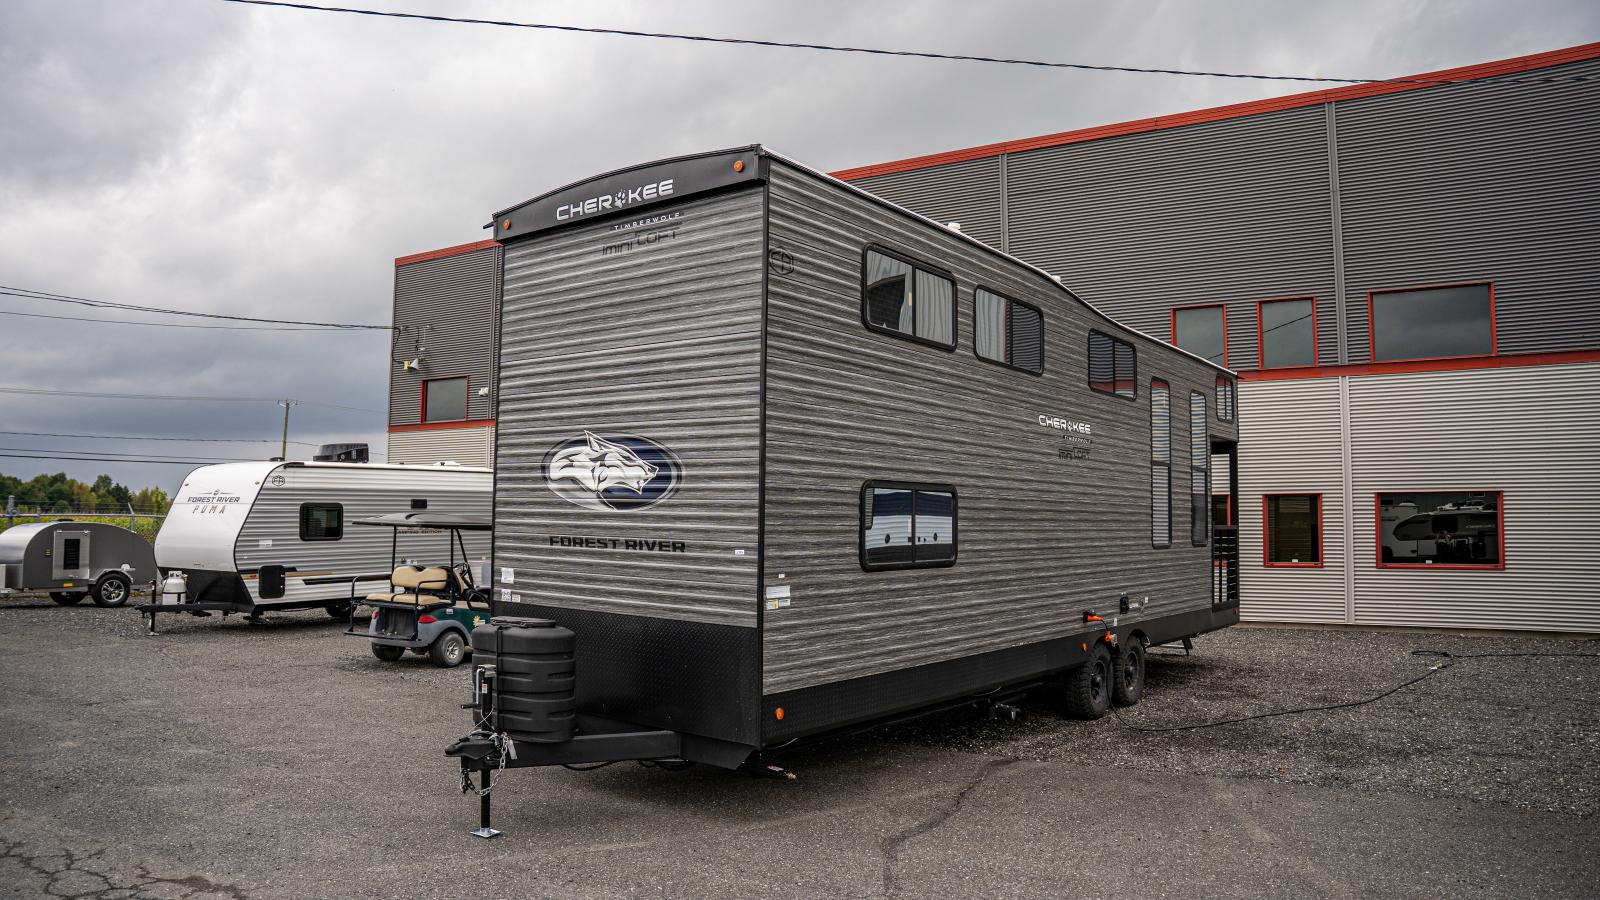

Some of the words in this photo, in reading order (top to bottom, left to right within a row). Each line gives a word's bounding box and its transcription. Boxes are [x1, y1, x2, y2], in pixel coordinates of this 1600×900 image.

[556, 178, 674, 221] CHEROKEE
[613, 212, 681, 231] TIMBERWOLF
[1038, 414, 1092, 435] CHEROKEE
[192, 504, 227, 515] PUMA
[549, 535, 620, 550] FOREST
[624, 538, 686, 553] RIVER
